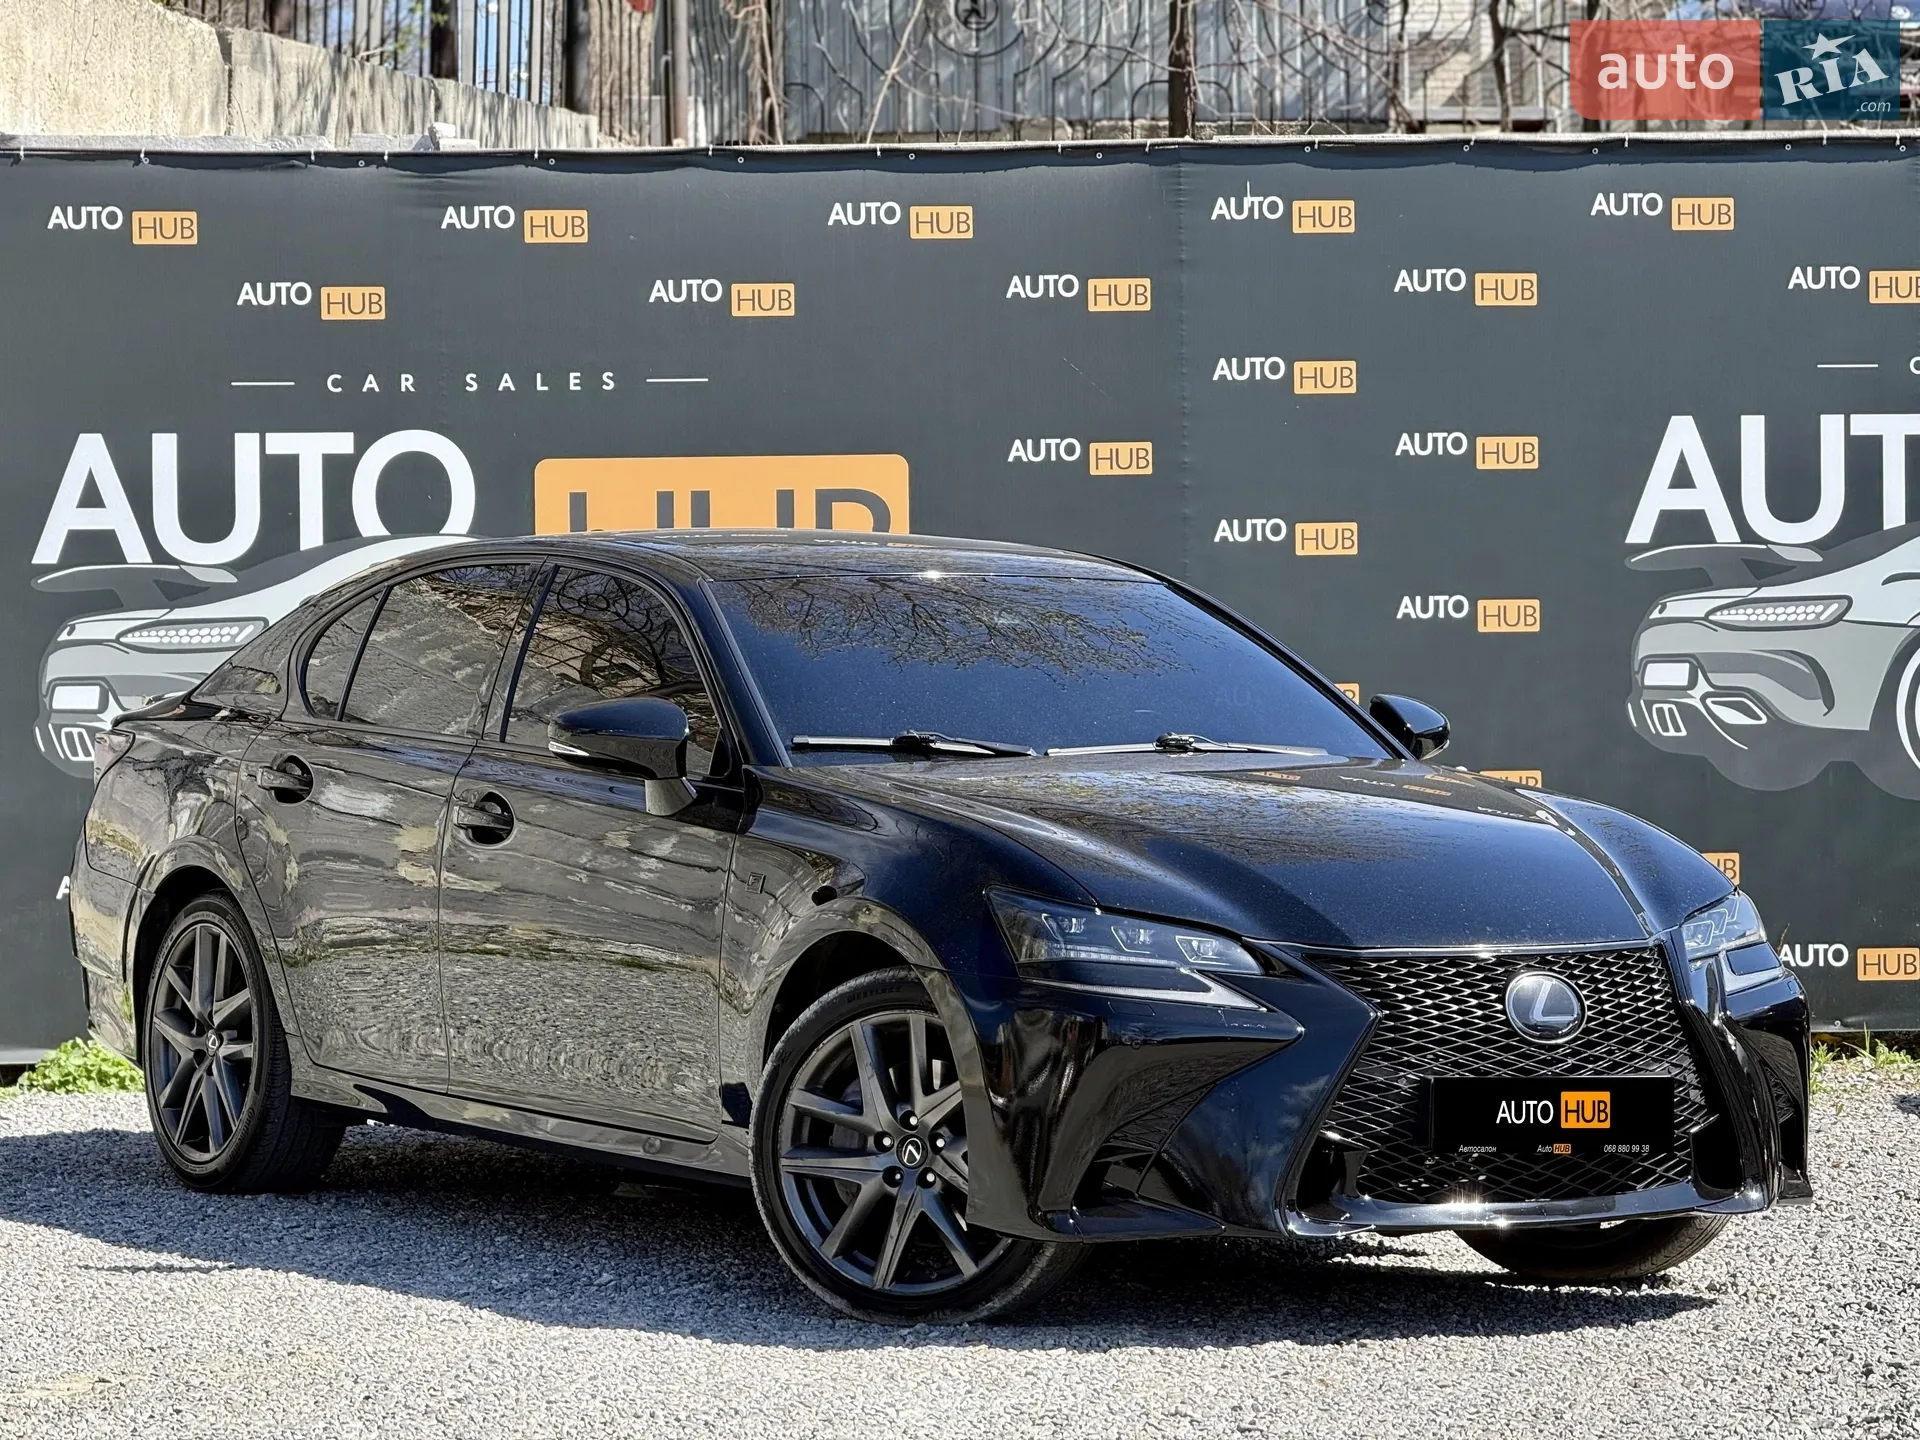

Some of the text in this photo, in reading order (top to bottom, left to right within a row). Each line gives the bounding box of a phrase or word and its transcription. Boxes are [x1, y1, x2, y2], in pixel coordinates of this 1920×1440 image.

[48, 206, 195, 240] AUTO HUB
[441, 206, 585, 239] AUTO HUB
[828, 202, 971, 234] AUTO HUB
[1211, 197, 1352, 229] AUTO HUB
[1591, 193, 1732, 226] AUTO HUB
[1006, 274, 1148, 307] AUTO HUB
[1394, 268, 1535, 301] AUTO HUB
[1788, 266, 1860, 289] AUTO
[237, 282, 383, 315] AUTO HUB
[649, 279, 792, 312] AUTO HUB
[327, 372, 615, 392] CAR SALES
[1213, 357, 1354, 389] AUTO HUB
[1008, 438, 1150, 471] AUTO HUB
[1396, 432, 1536, 465] AUTO HUB
[31, 429, 476, 564] AUTO
[1214, 518, 1355, 551] AUTO HUB
[1397, 595, 1537, 628] AUTO HUB
[1779, 943, 1917, 976] AUTO HUB
[1496, 1100, 1609, 1124] AUTO HUB
[1459, 1144, 1497, 1153] Автосалон
[1537, 1144, 1650, 1153] Auto HUB 068 880 99 38
